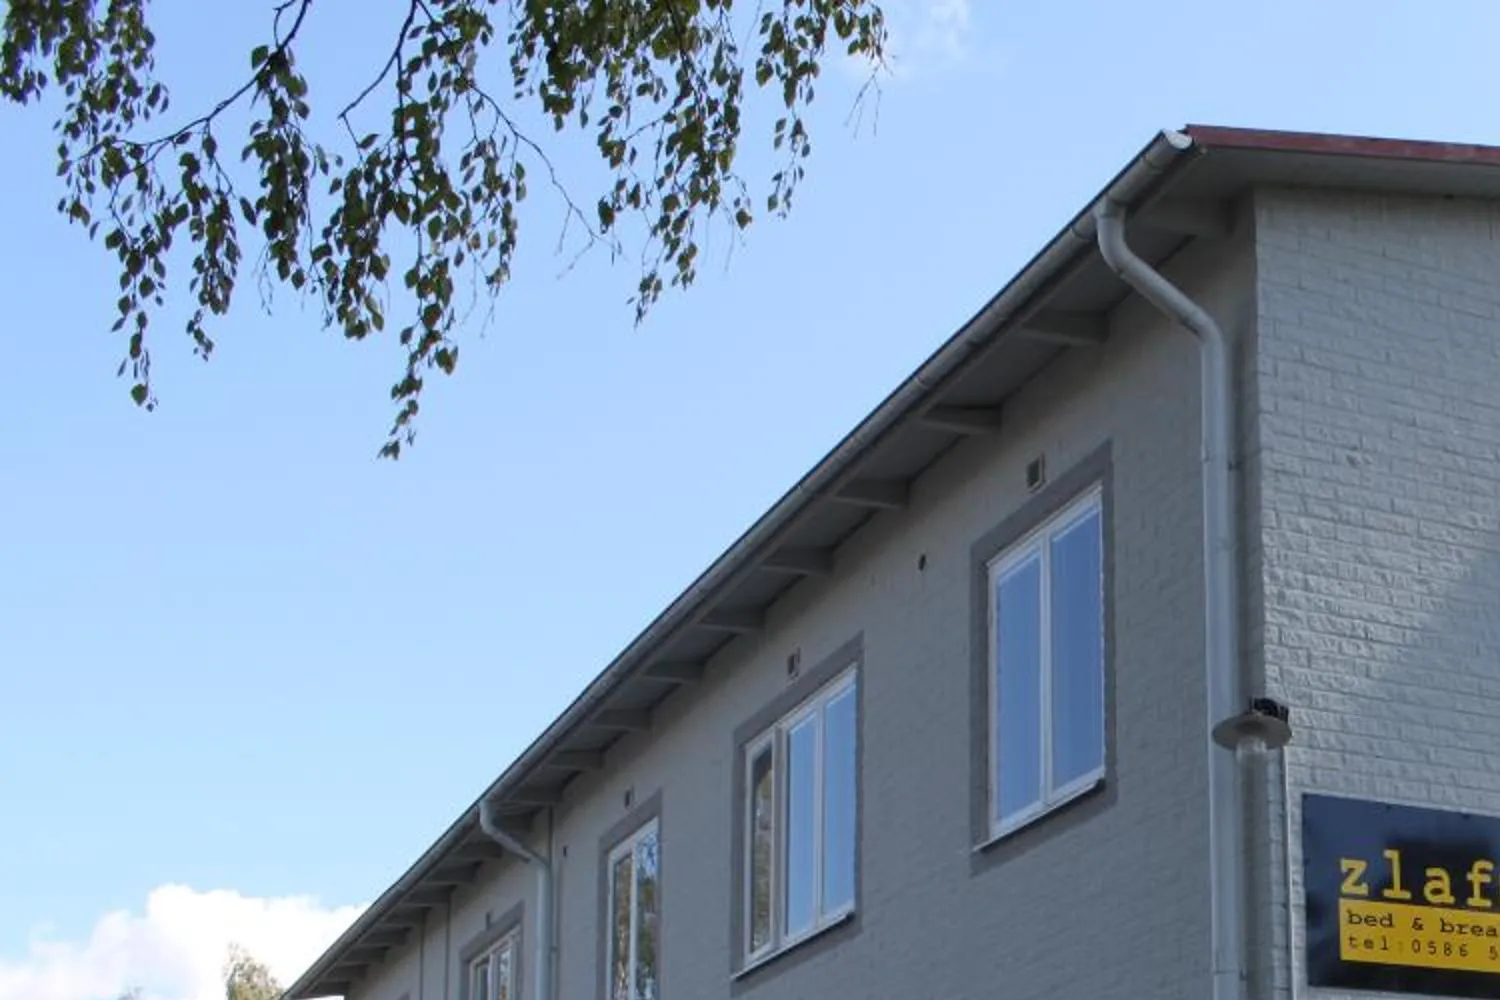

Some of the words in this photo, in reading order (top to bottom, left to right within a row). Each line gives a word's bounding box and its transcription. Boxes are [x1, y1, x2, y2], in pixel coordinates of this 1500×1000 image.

[1347, 910, 1395, 929] bed
[1411, 915, 1425, 931] &
[1411, 938, 1469, 958] 0586
